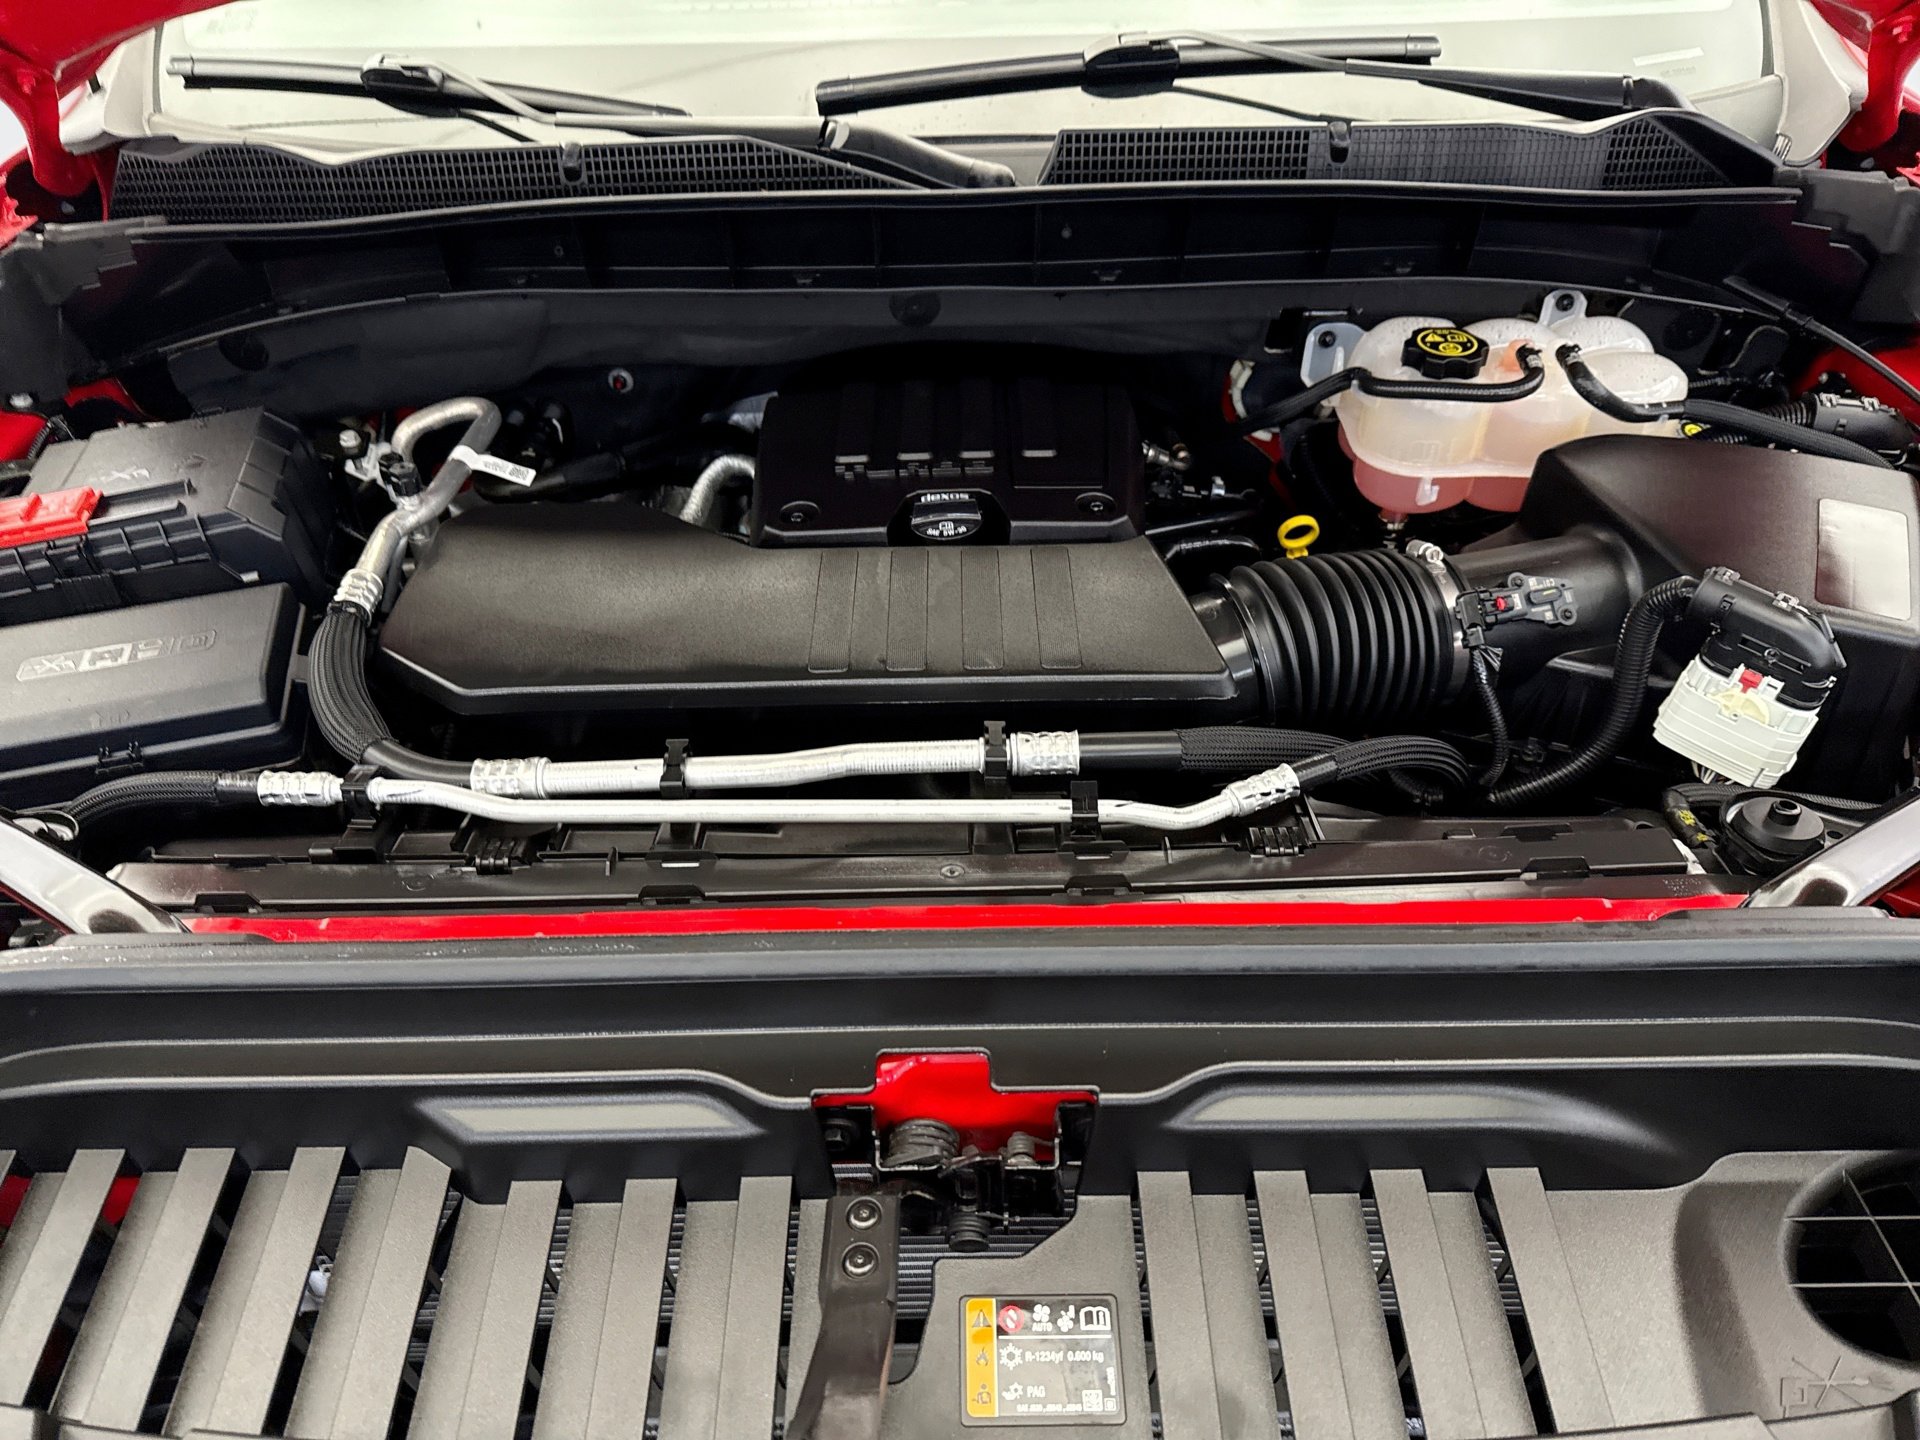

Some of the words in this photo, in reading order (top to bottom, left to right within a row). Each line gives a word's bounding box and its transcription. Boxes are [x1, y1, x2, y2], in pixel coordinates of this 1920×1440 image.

[921, 493, 969, 502] dexos
[1032, 1322, 1053, 1331] AUTO
[1025, 1350, 1063, 1364] R-1234yf
[1093, 1350, 1104, 1364] kg
[1027, 1385, 1046, 1398] PAG
